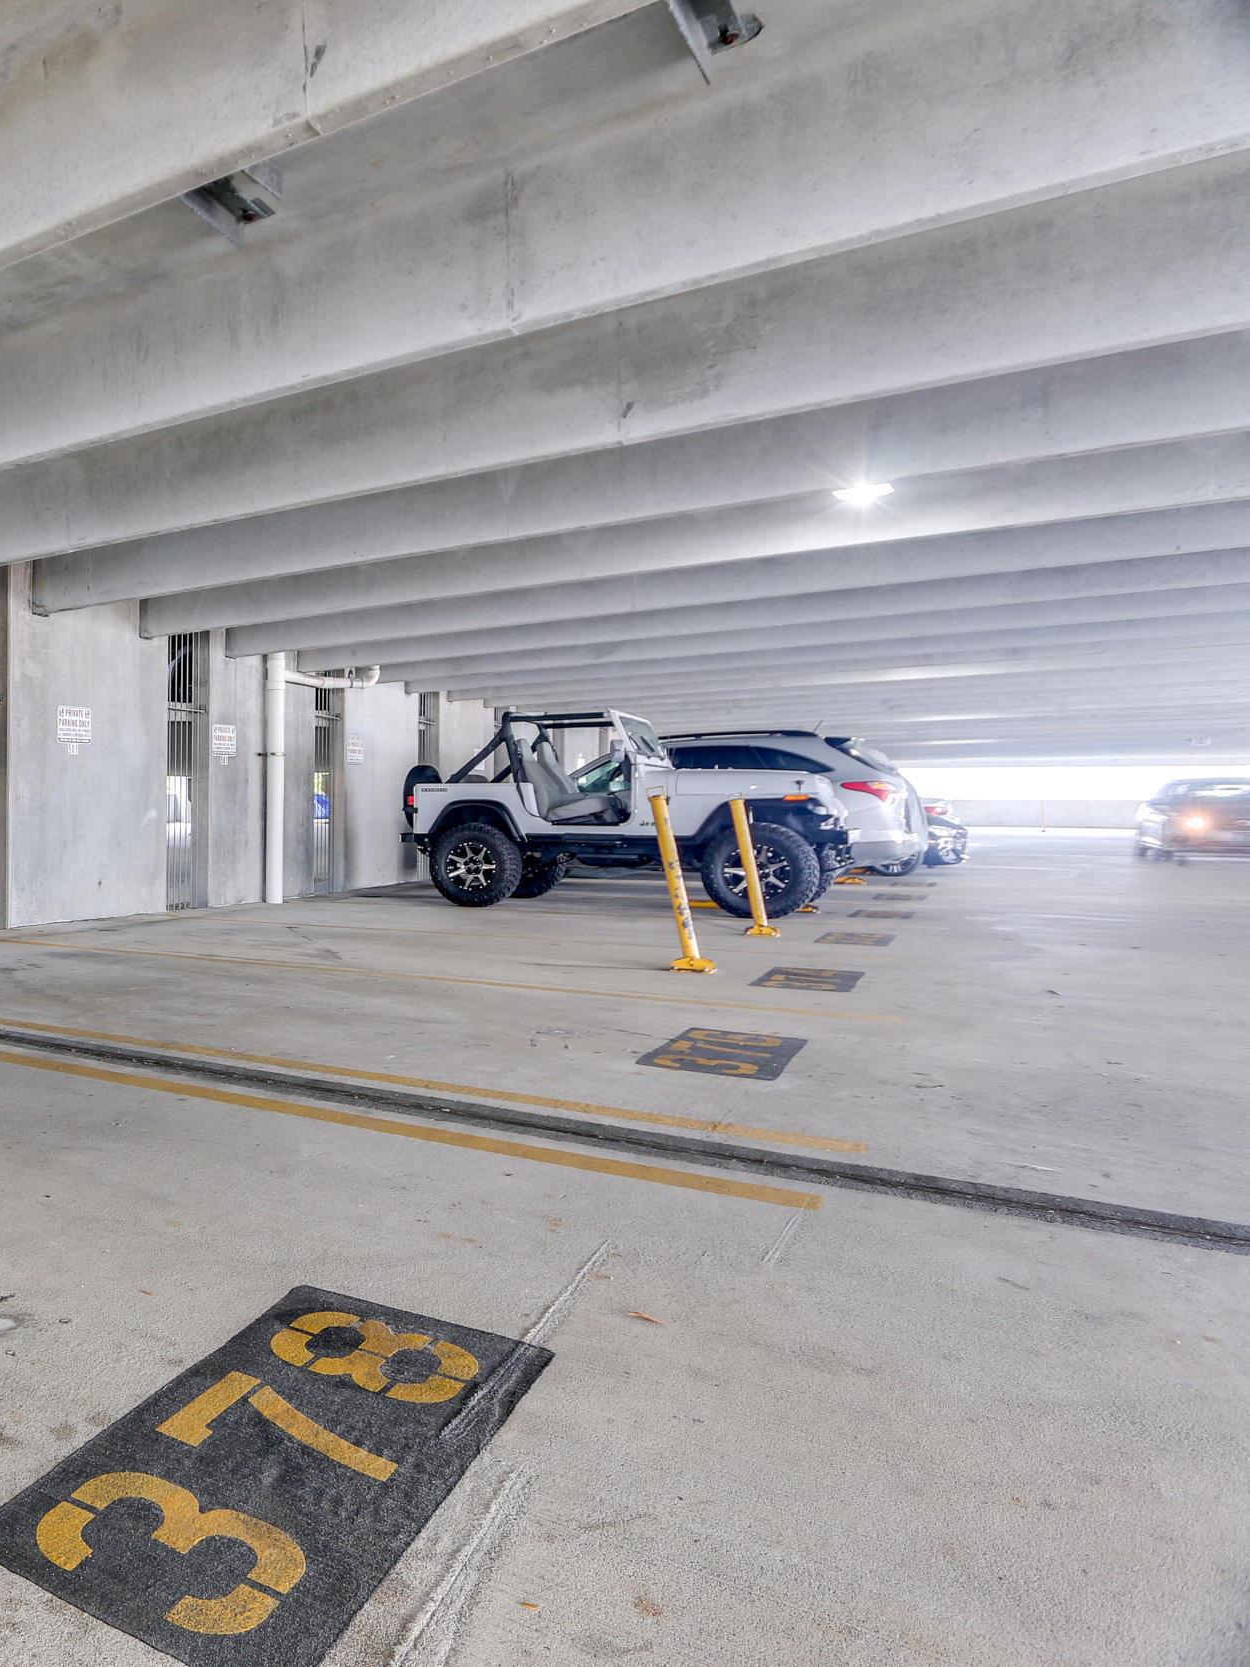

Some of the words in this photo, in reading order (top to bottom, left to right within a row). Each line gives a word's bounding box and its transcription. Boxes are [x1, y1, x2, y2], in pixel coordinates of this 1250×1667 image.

[59, 719, 78, 727] PARKING
[78, 719, 90, 728] ONLY
[65, 709, 83, 718] PRIVATE
[653, 1030, 783, 1075] 376
[35, 1310, 480, 1636] 378
